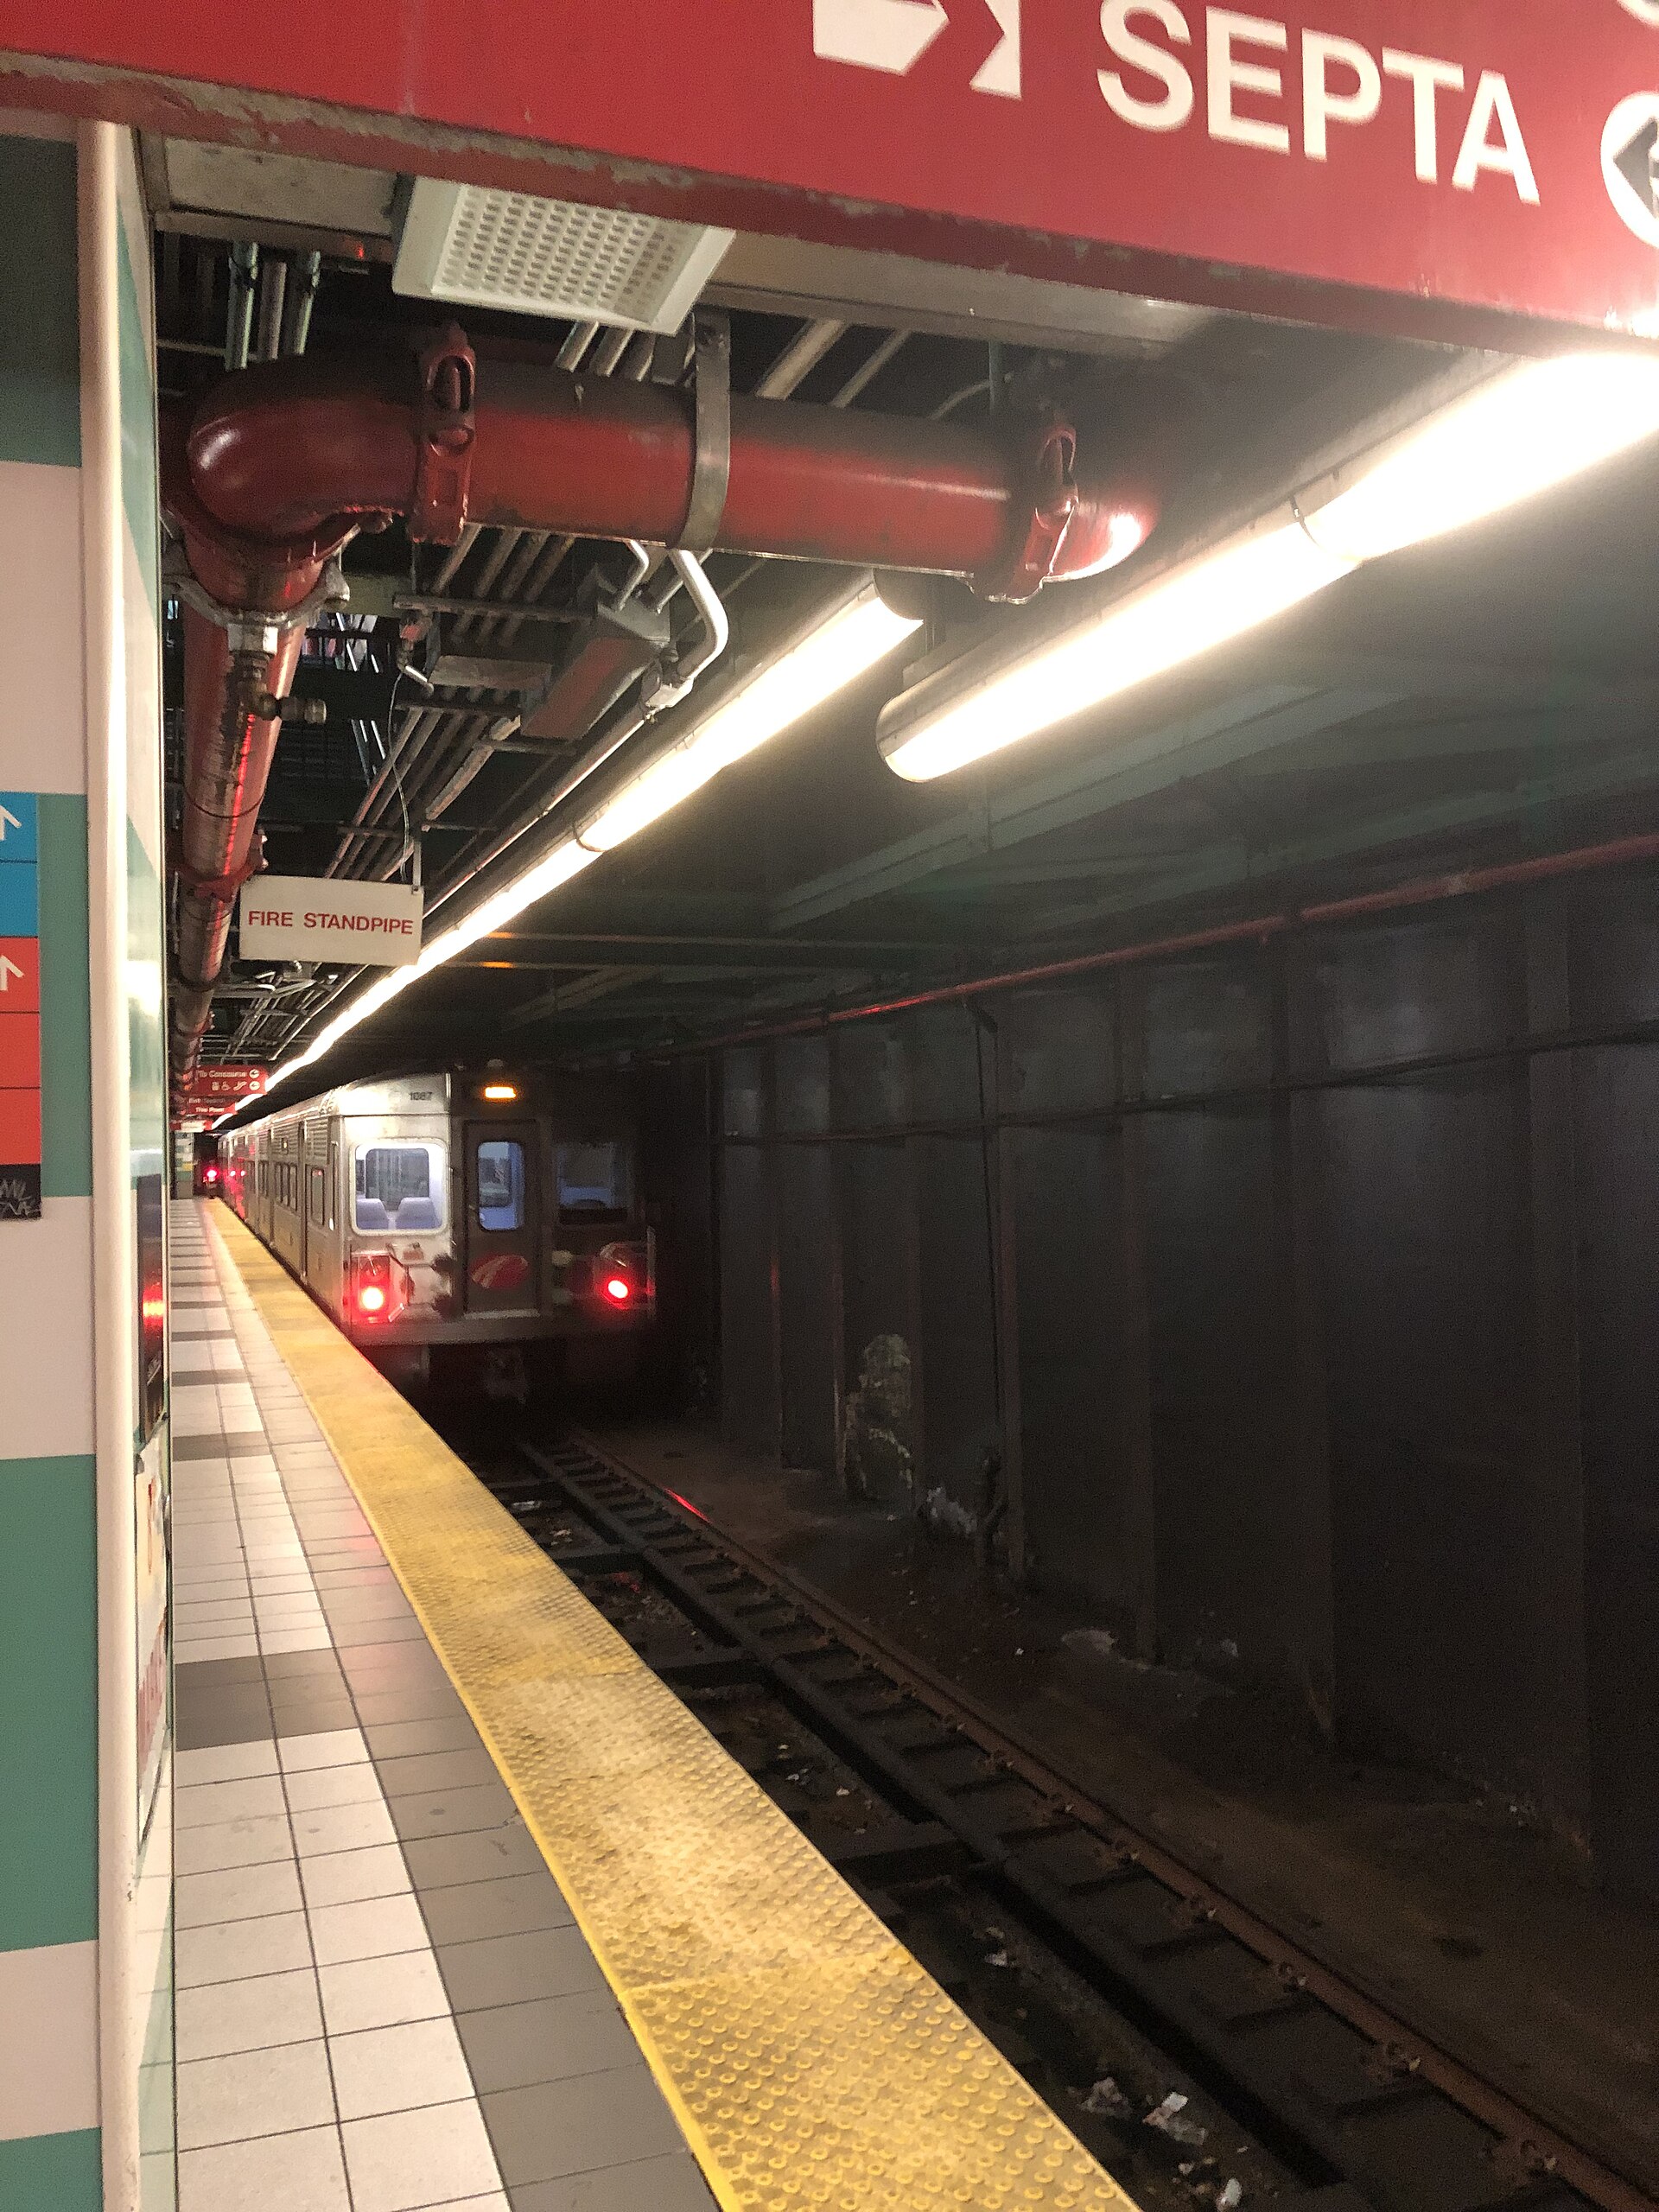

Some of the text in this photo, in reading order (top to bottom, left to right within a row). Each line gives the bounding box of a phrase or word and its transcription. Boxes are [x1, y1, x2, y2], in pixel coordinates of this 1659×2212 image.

[1096, 0, 1542, 207] SEPTA
[248, 910, 414, 936] FIRE STANDPIPE
